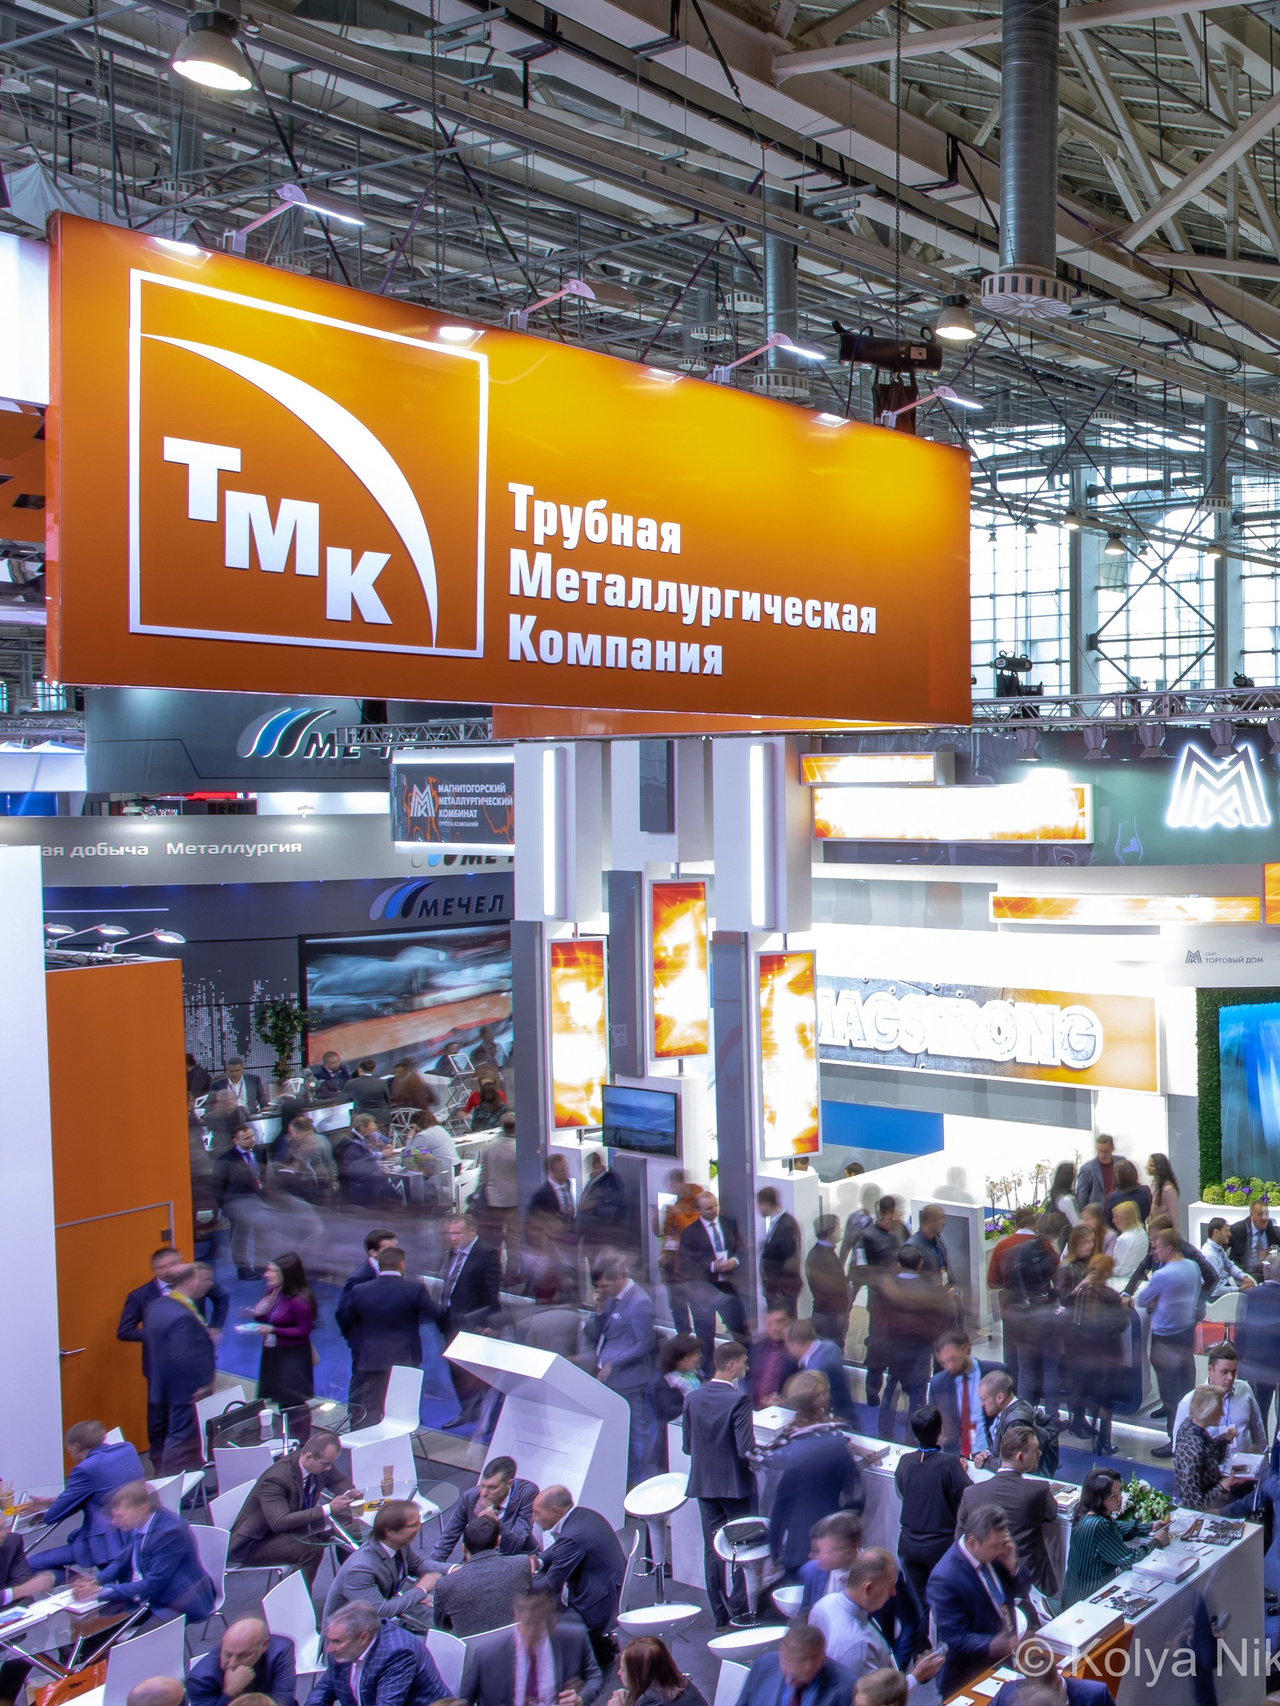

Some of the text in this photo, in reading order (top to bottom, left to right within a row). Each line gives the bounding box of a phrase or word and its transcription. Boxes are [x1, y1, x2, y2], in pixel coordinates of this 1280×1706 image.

[508, 482, 681, 555] Трубная
[509, 548, 877, 634] Металлургическая
[508, 613, 723, 676] Компания
[438, 783, 506, 793] МАГНИТОГОРСКИЙ
[438, 795, 513, 806] МЕТАЛЛУРГИЧЕСКИЙ
[439, 809, 478, 818] КОМБИНАТ
[70, 842, 149, 858] добыча
[166, 842, 302, 857] Металлургия
[417, 894, 504, 918] МЕЧЕЛ
[1205, 956, 1244, 964] ТОРГОВЫЙ
